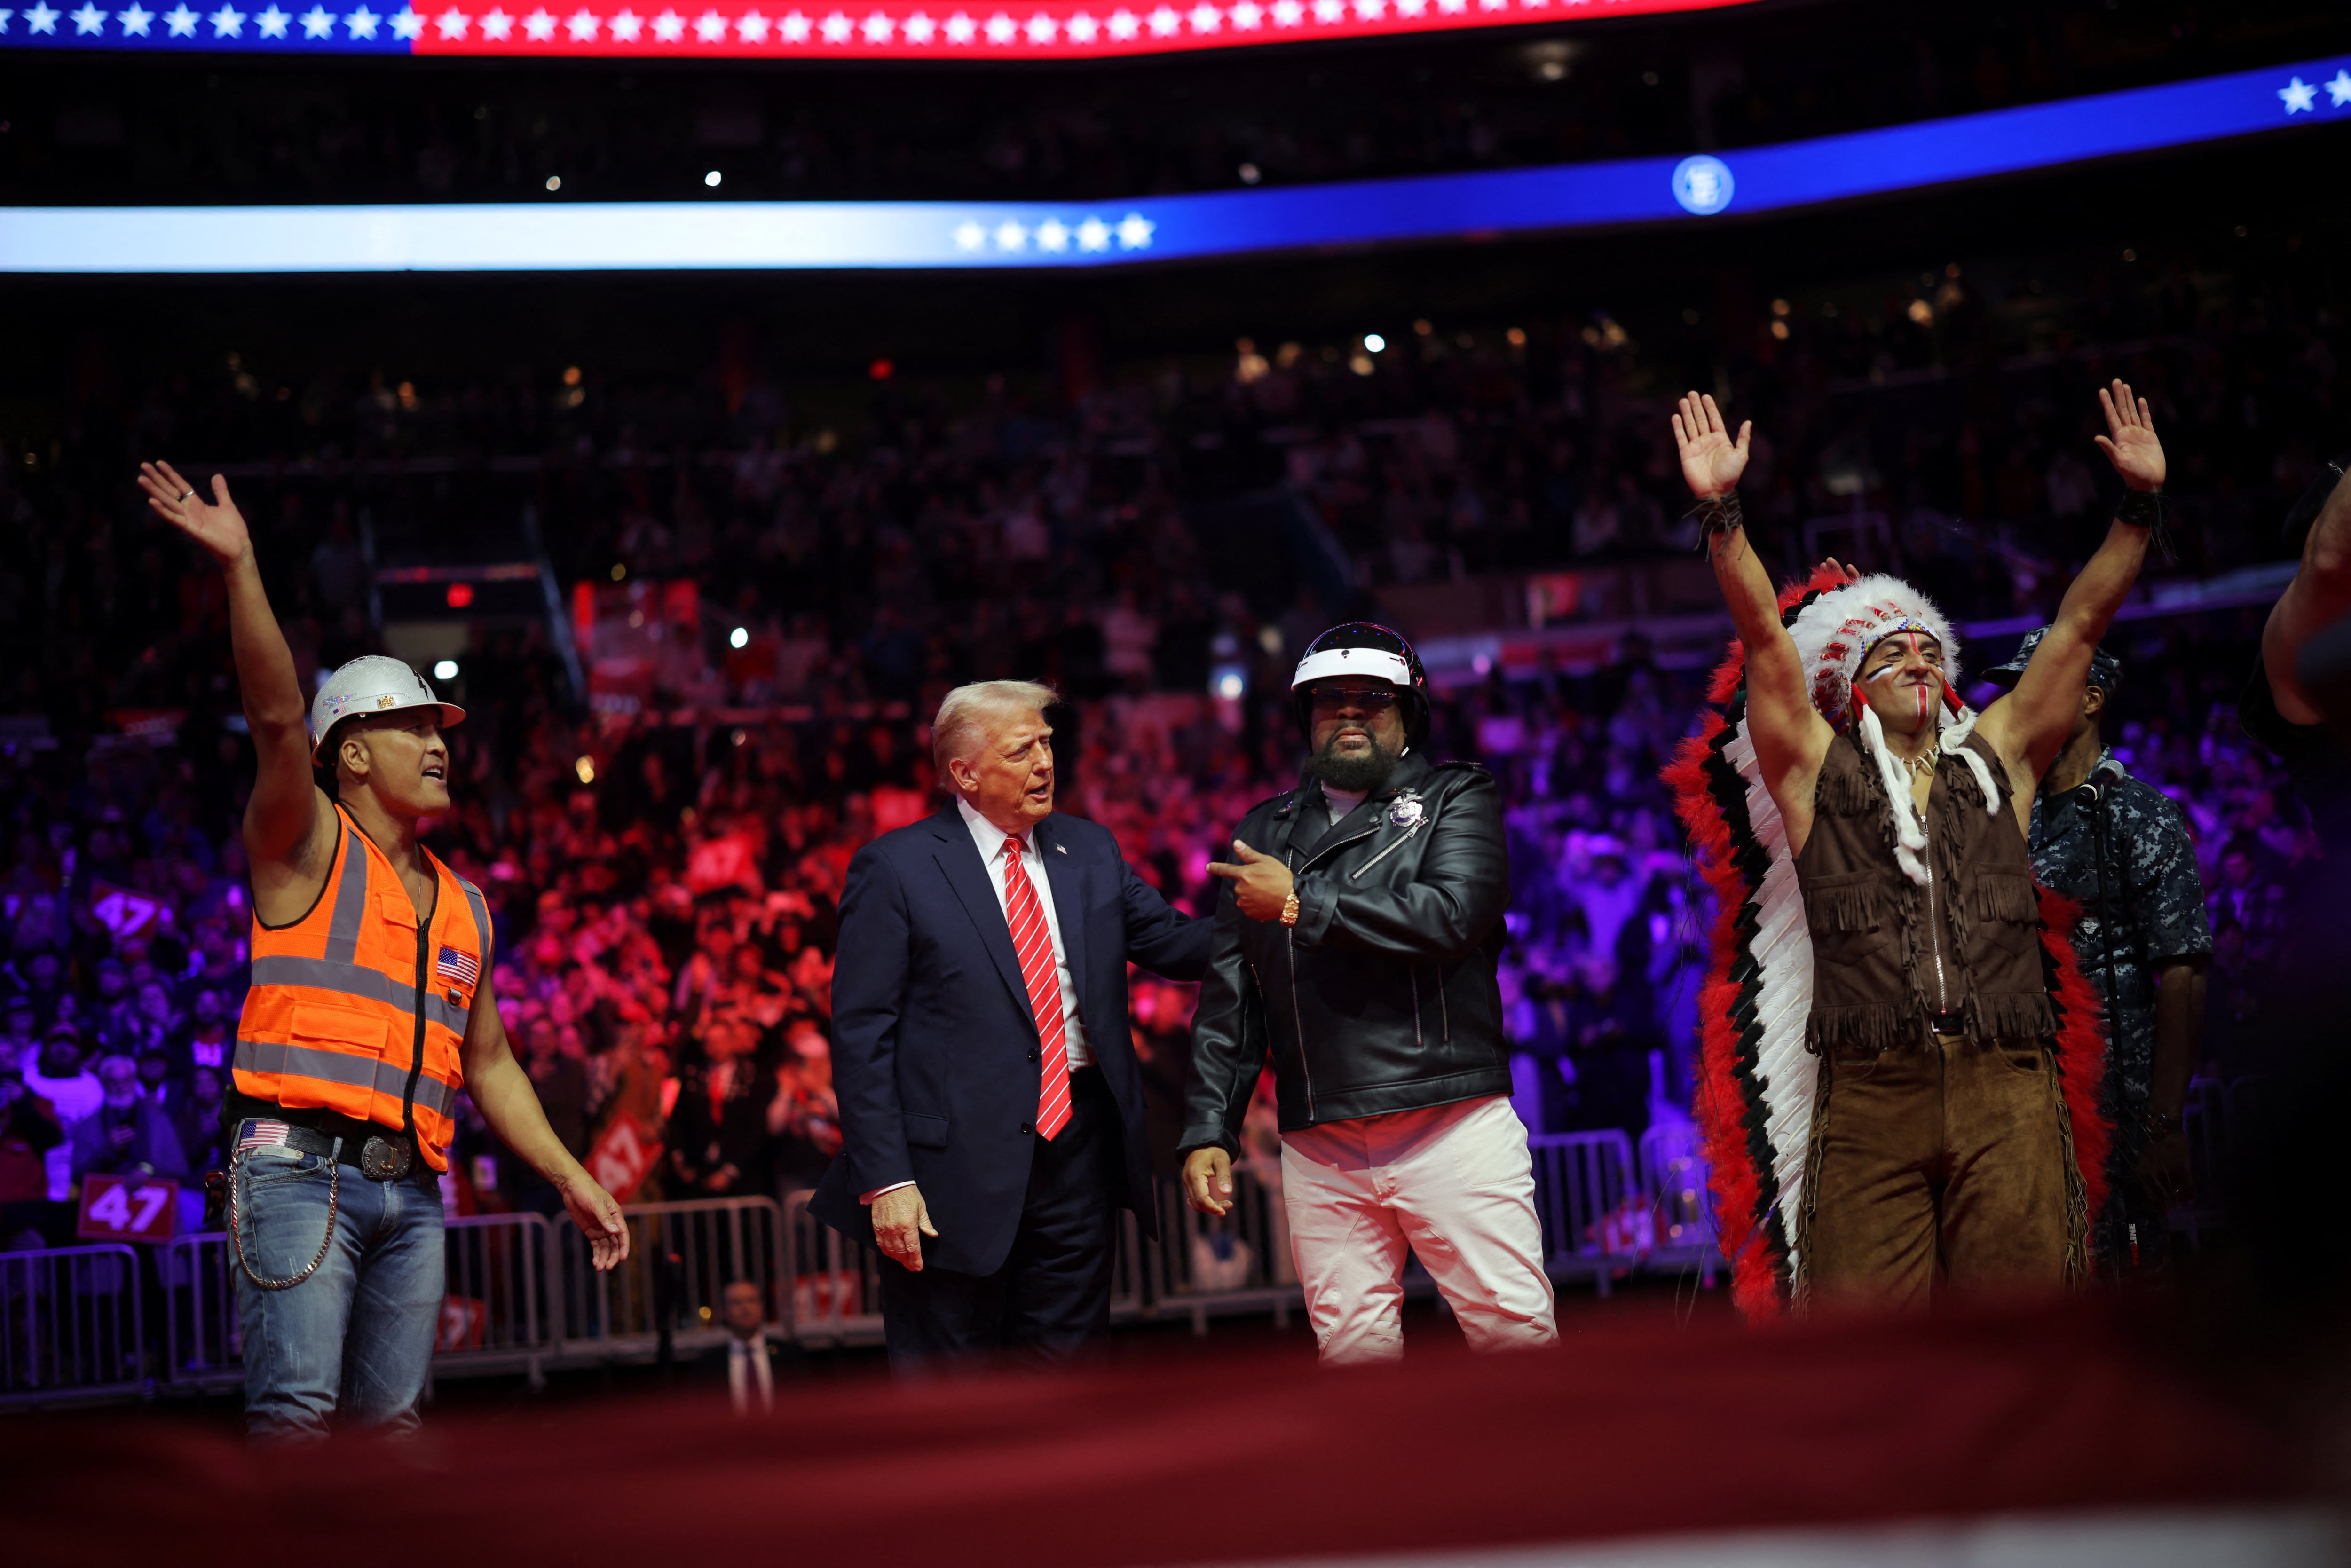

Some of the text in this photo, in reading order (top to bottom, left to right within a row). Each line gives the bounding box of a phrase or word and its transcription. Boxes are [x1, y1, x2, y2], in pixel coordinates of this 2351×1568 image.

[94, 892, 156, 936] 47
[380, 1146, 398, 1170] J
[594, 1121, 644, 1194] 47
[88, 1183, 169, 1233] 47
